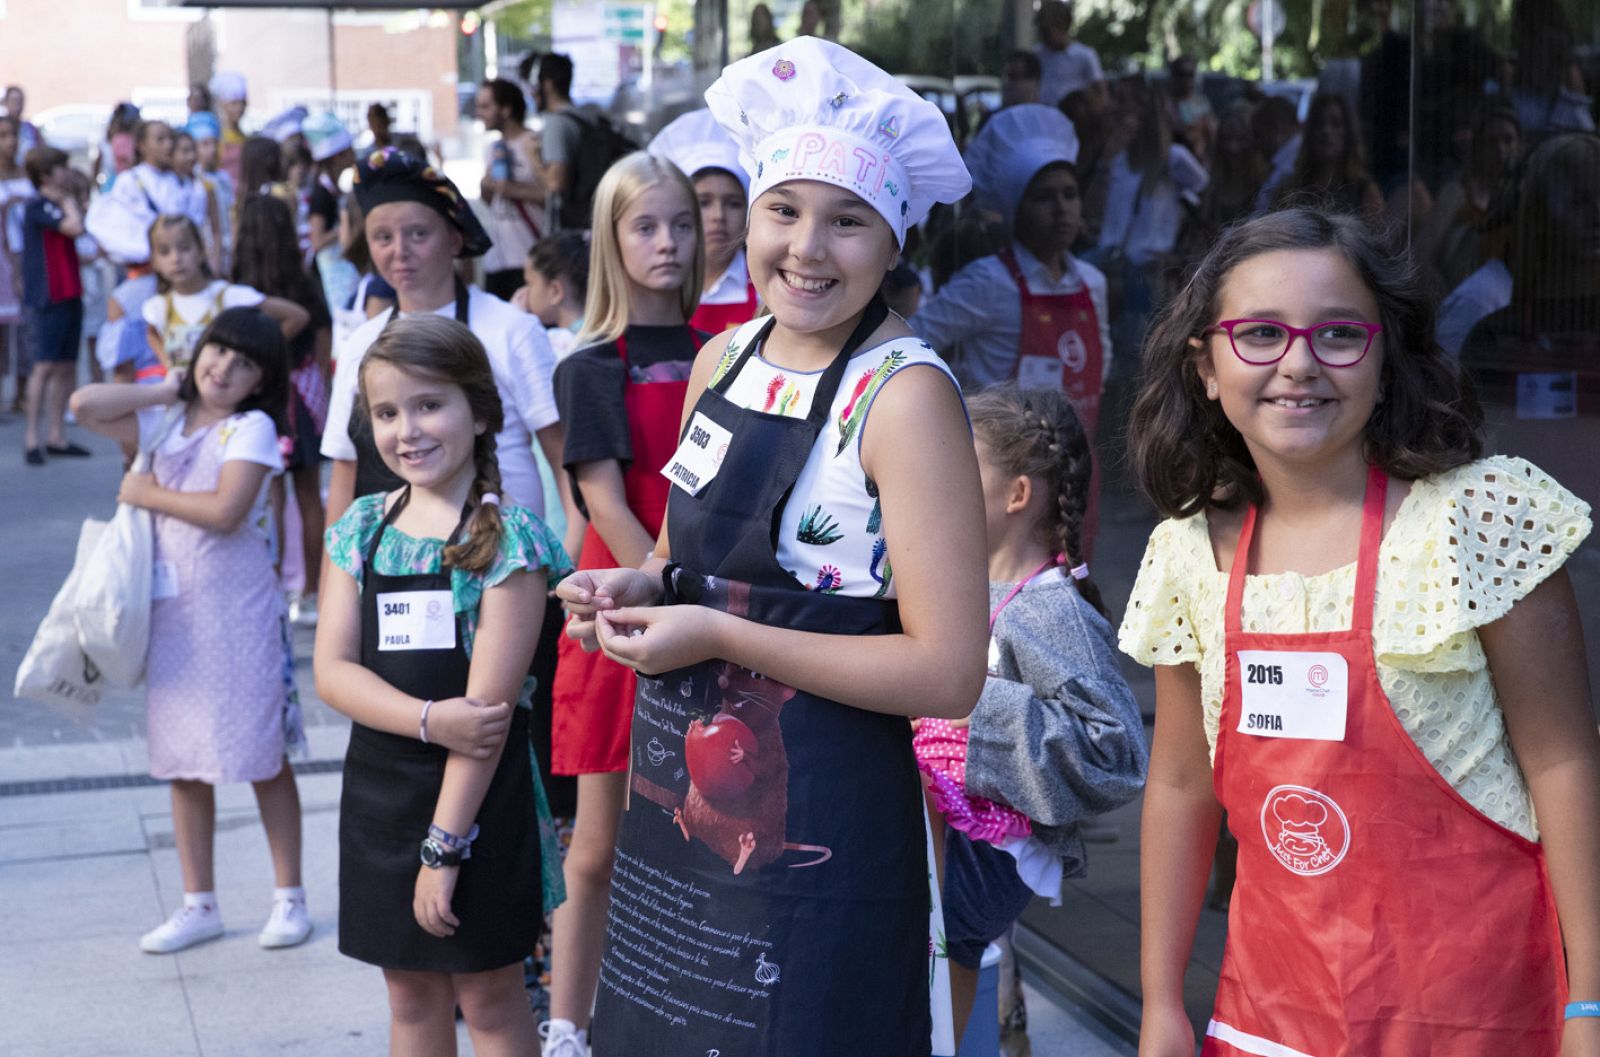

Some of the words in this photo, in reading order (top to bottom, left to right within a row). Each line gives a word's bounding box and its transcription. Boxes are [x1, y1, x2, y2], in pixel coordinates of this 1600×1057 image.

[689, 425, 711, 449] 3503
[670, 462, 700, 489] PATRICIA
[384, 602, 410, 616] 3401
[385, 634, 411, 645] PAULA
[1247, 664, 1283, 685] 2015
[1247, 713, 1283, 731] SOFIA
[1293, 857, 1310, 870] For
